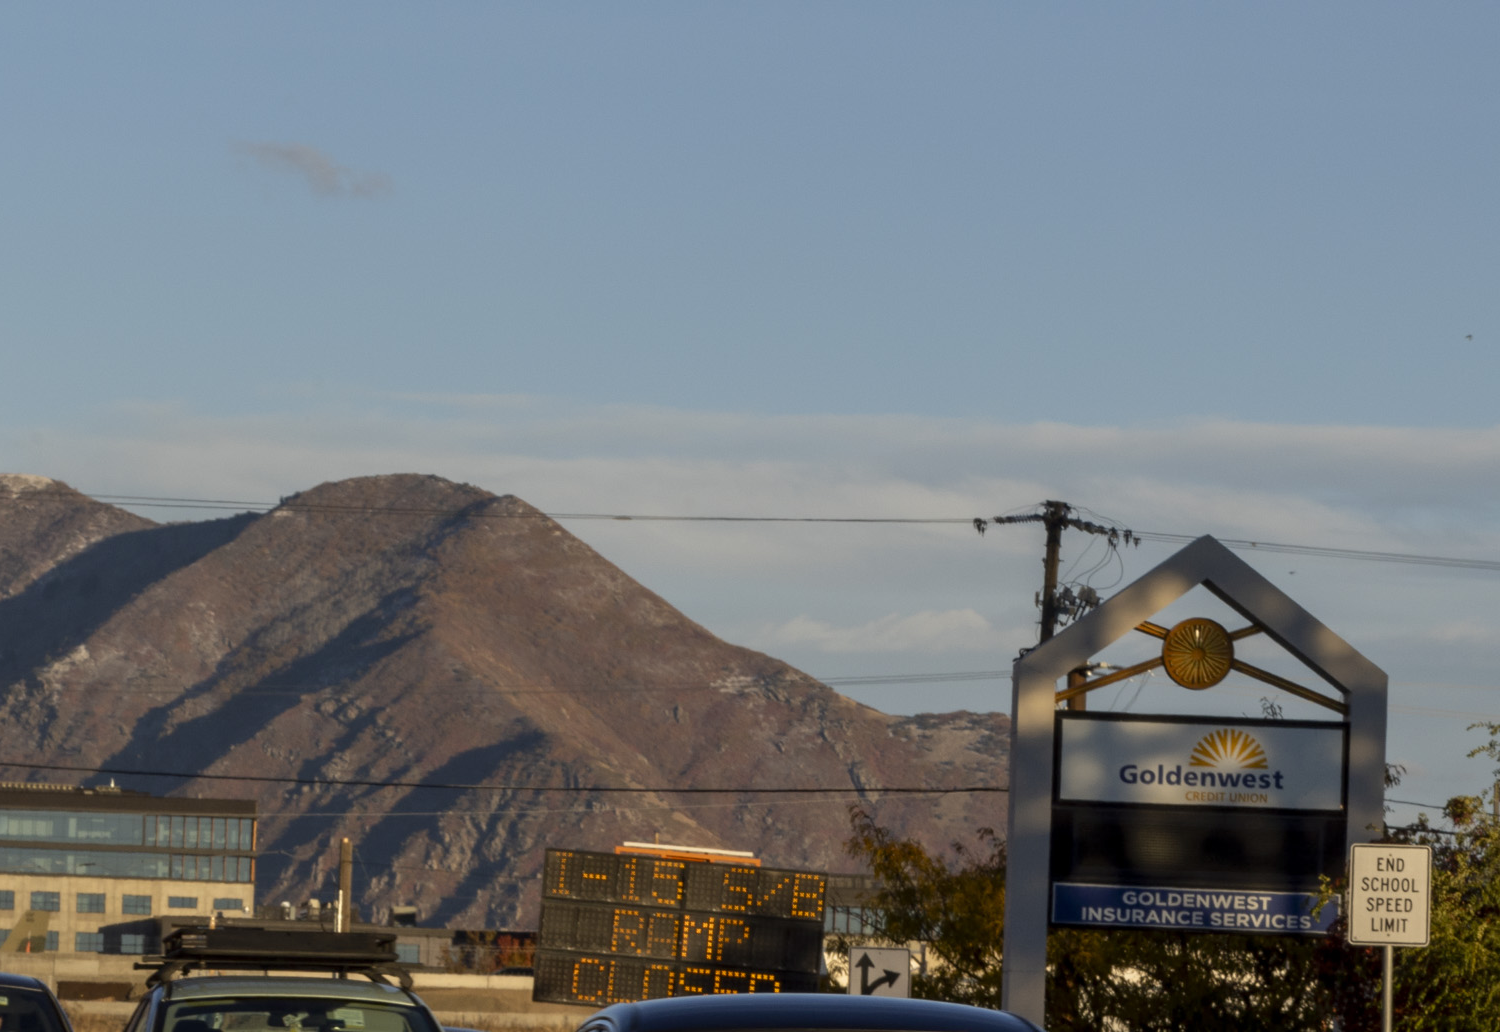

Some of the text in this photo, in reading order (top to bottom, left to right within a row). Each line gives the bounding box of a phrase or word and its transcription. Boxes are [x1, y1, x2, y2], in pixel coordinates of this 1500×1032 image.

[1119, 764, 1283, 789] Goldenwest
[1185, 791, 1268, 803] CREDIT UNION
[1376, 857, 1405, 872] END
[551, 852, 825, 917] I-15 S/B
[1361, 877, 1419, 893] SCHOOL
[1122, 891, 1272, 911] GOLDENWEST
[1366, 897, 1413, 913] SPEED
[1081, 907, 1312, 929] INSURANCE SERVICES
[1371, 917, 1408, 933] LIMIT
[611, 909, 749, 961] RAMP
